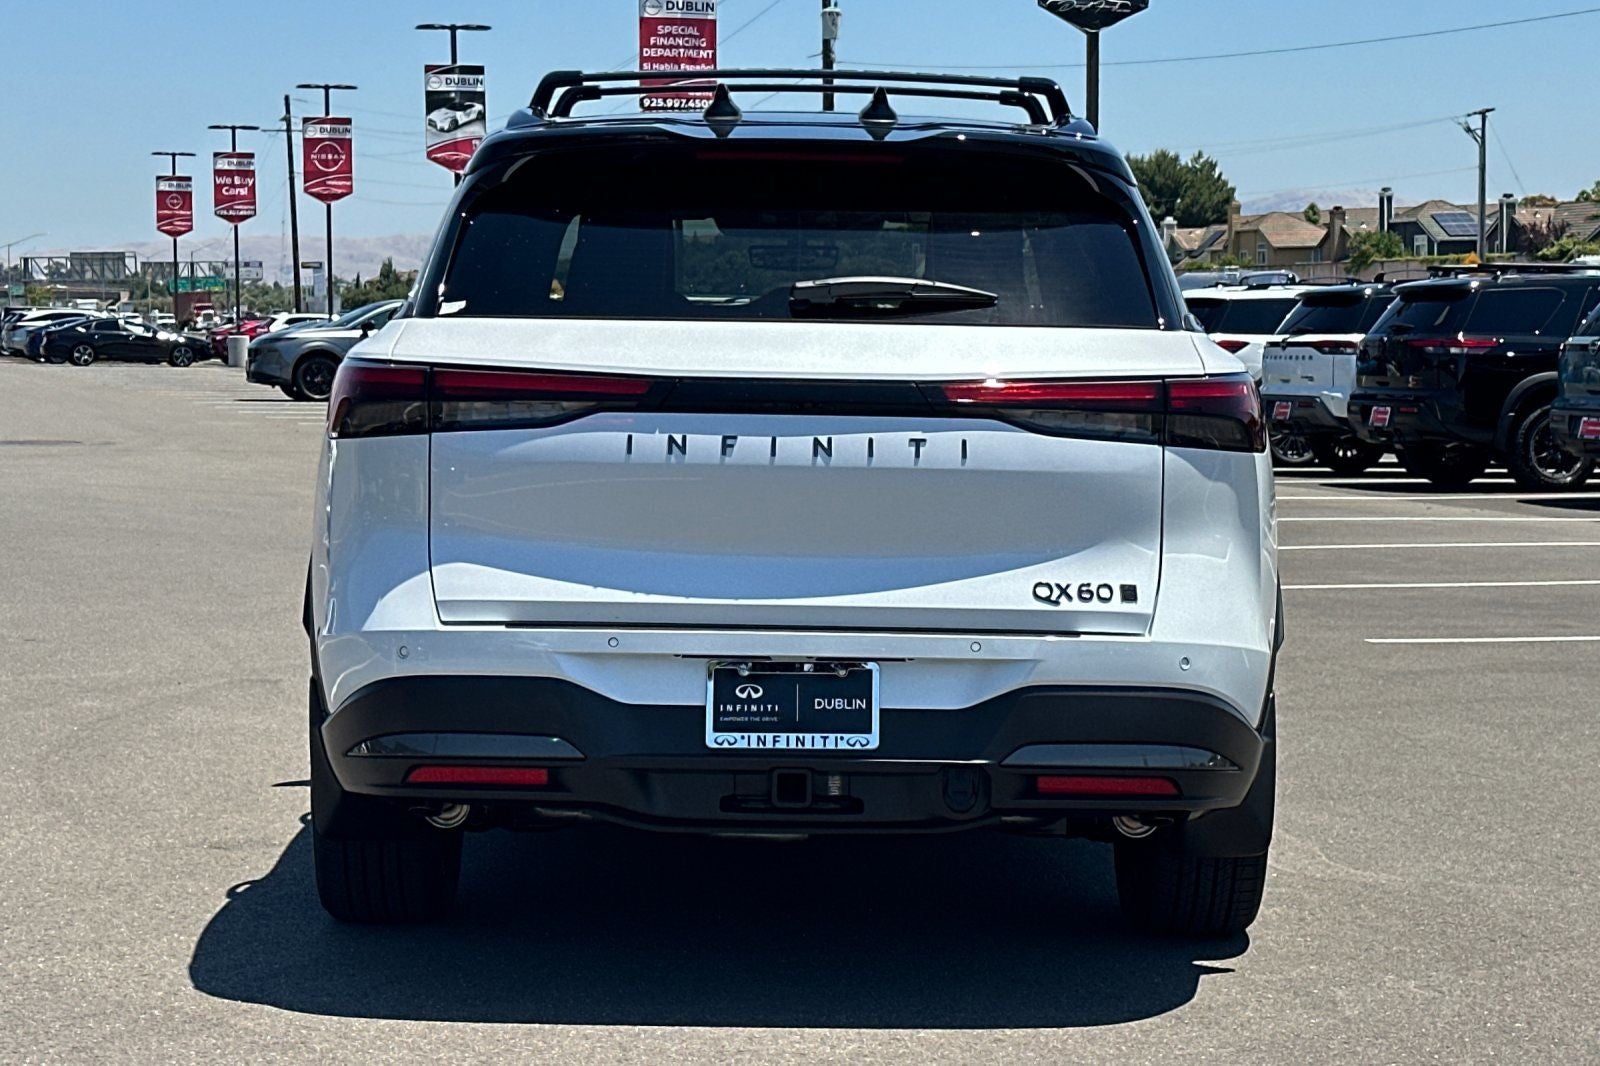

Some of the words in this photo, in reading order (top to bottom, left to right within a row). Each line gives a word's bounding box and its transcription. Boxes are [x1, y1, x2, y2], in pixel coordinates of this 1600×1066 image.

[665, 1, 715, 13] DUBLIN
[657, 25, 700, 36] SPECIAL
[649, 36, 707, 47] FINANCING
[642, 48, 714, 59] DEPARTMENT
[652, 62, 679, 71] Habla
[445, 77, 483, 86] DUBLIN
[319, 126, 351, 134] DUBLIN
[215, 175, 232, 185] We
[233, 175, 254, 187] Buy
[221, 186, 248, 196] Cars!
[625, 433, 968, 460] INFINITI
[1032, 581, 1114, 607] QX60
[719, 704, 779, 712] INFINITI
[814, 698, 866, 710] DUBLIN
[746, 734, 839, 748] INFINITI
